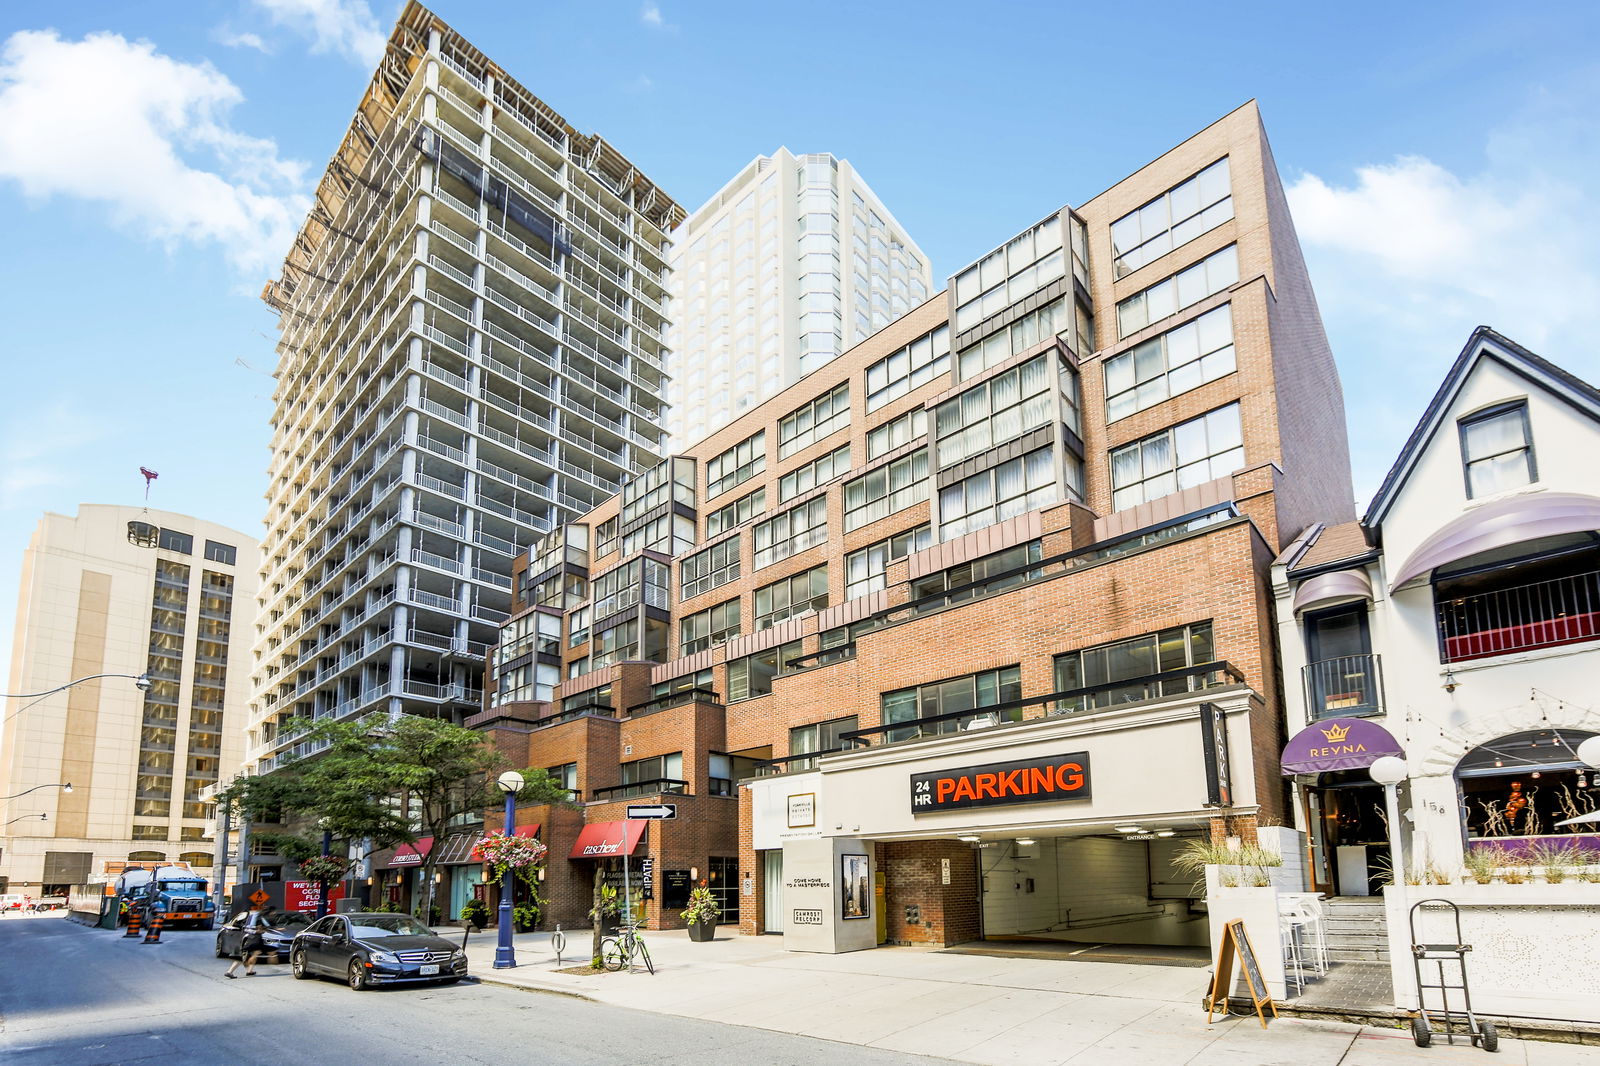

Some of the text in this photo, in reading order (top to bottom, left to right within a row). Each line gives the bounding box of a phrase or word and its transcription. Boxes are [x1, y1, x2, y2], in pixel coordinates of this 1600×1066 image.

[1310, 744, 1366, 757] REYNA
[915, 781, 930, 793] 24
[936, 762, 1084, 804] PARKING
[914, 794, 932, 806] HR
[643, 859, 653, 884] PATH
